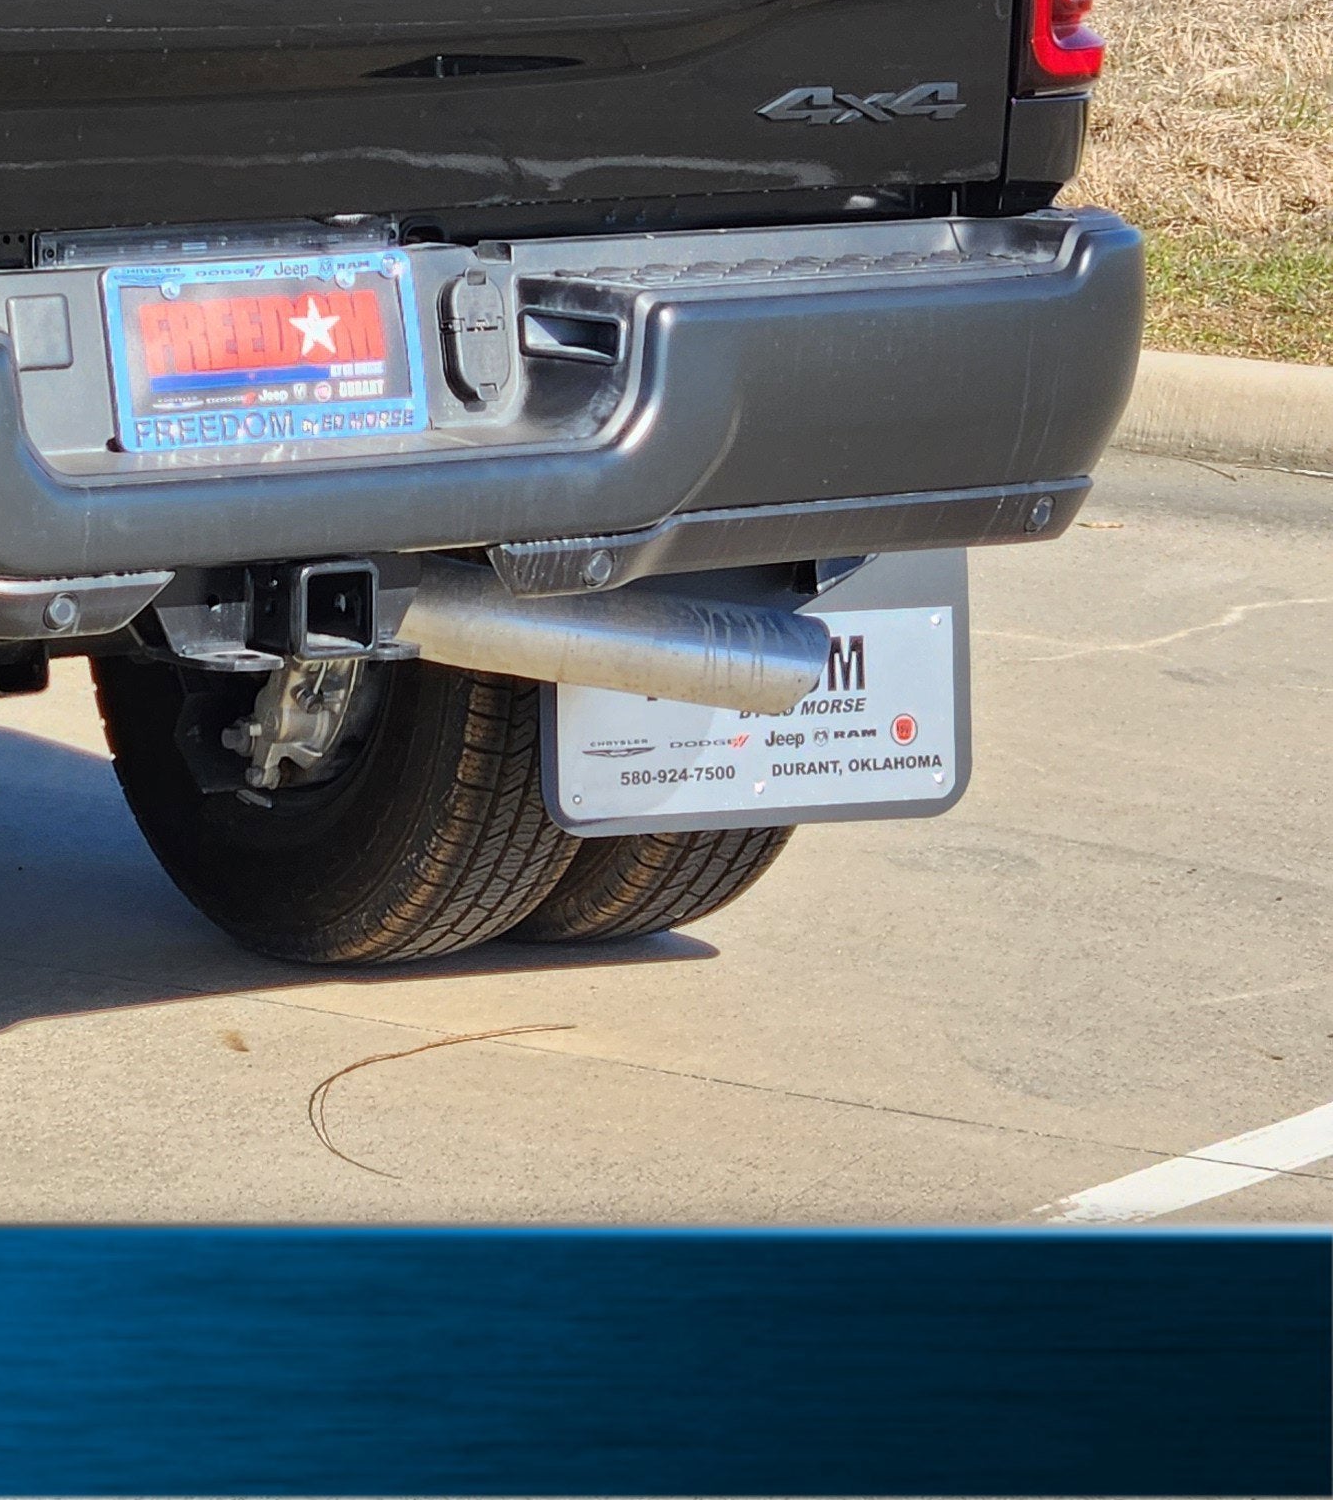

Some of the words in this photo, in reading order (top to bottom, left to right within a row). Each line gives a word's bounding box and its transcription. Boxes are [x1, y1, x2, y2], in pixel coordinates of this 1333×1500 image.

[274, 261, 309, 277] Jeep
[135, 411, 295, 448] FREEDOM
[800, 697, 867, 716] MORSE
[765, 730, 806, 749] Jeep
[833, 728, 877, 740] RAM
[620, 765, 736, 786] 580-924-7500
[772, 760, 844, 777] DURANT,
[848, 755, 943, 773] OKLAHOMA
